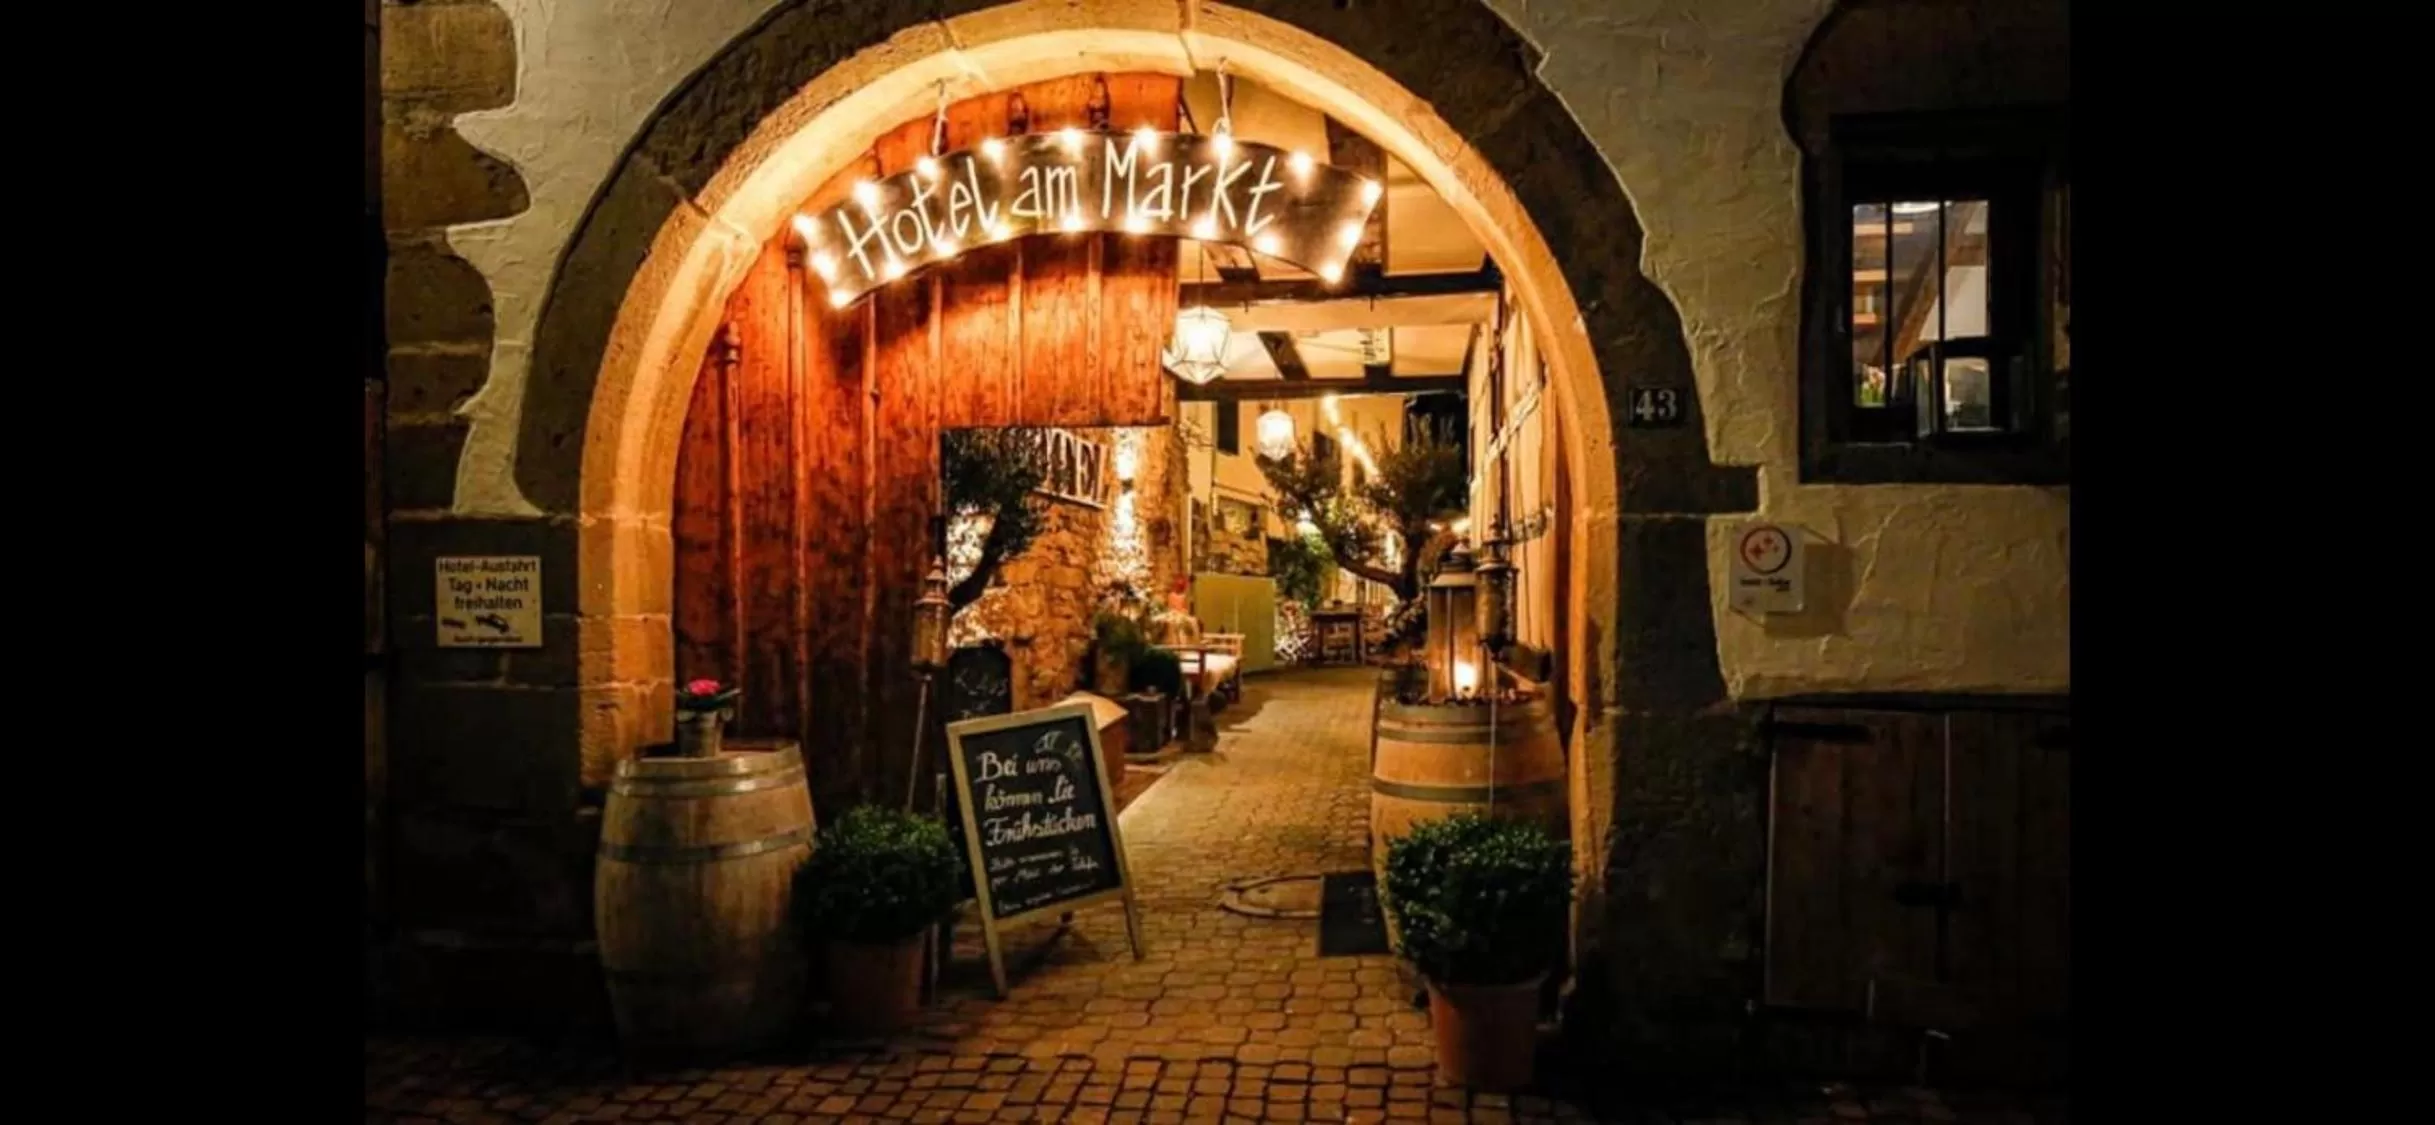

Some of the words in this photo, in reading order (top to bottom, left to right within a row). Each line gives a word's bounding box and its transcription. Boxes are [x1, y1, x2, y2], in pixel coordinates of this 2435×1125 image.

[838, 160, 998, 279] Hotel
[1011, 163, 1081, 220] am
[1102, 138, 1283, 236] Markt
[1635, 389, 1677, 421] 43
[448, 577, 473, 594] Tag
[485, 576, 529, 592] Nacht
[454, 595, 523, 610] freihalten
[974, 751, 1018, 783] Bei
[1026, 757, 1062, 774] uns
